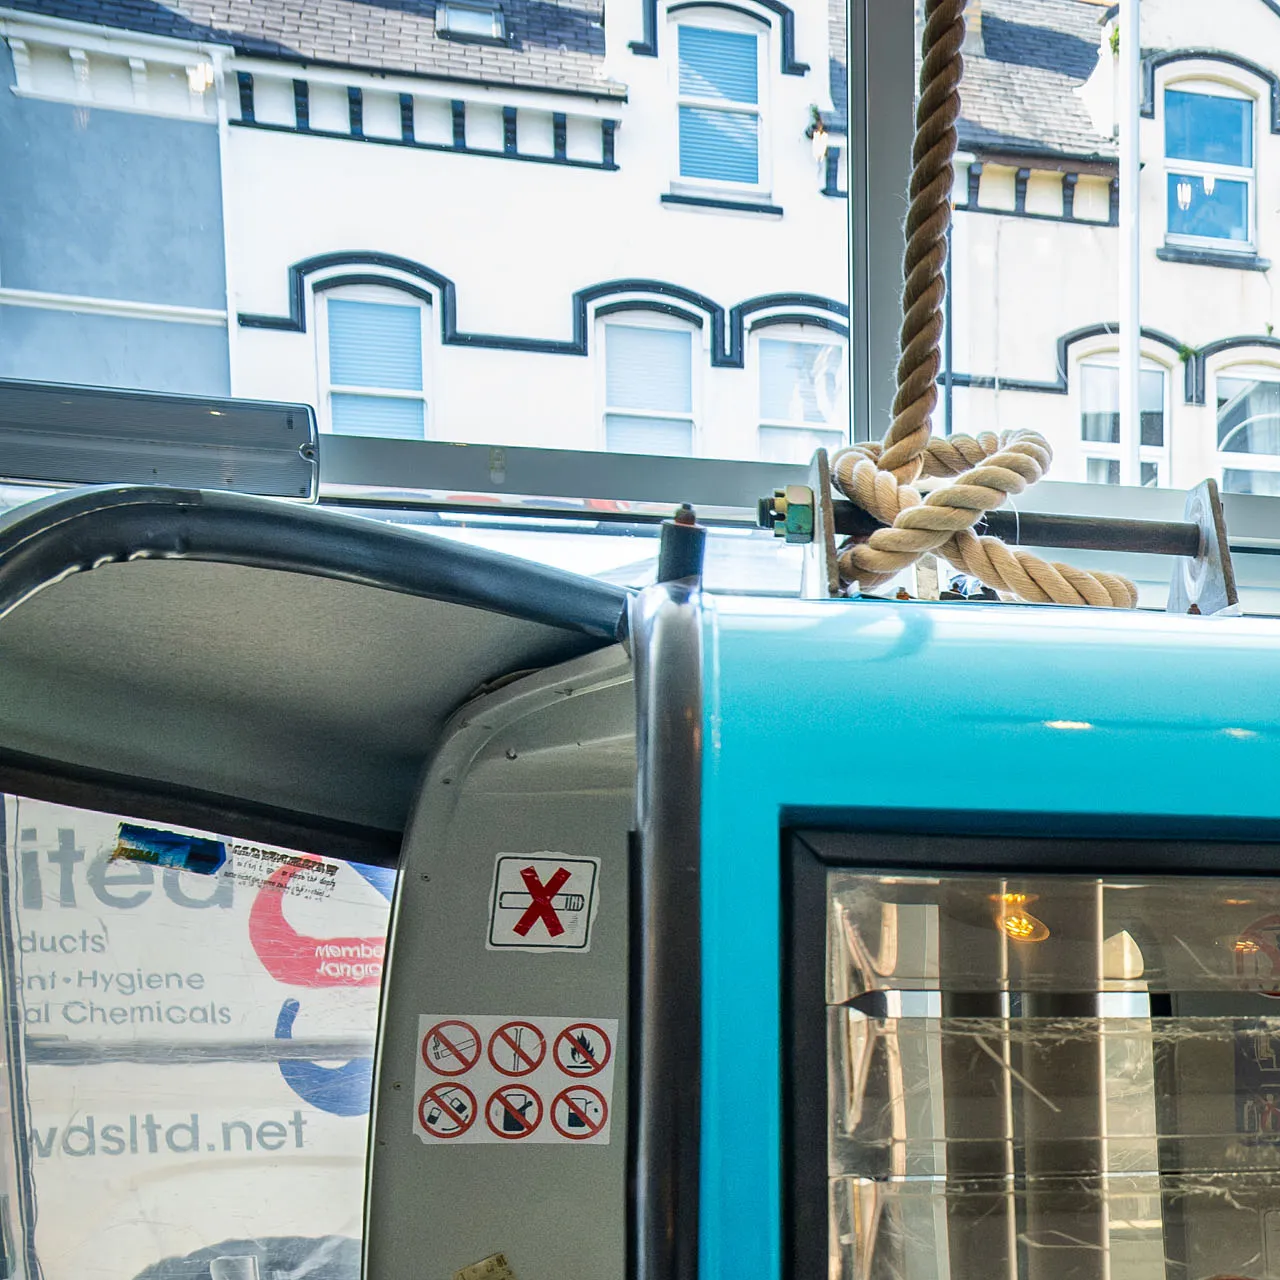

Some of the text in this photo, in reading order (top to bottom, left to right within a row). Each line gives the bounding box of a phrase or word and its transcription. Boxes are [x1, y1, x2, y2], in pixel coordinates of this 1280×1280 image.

[20, 930, 106, 953] ducts
[77, 968, 205, 996] Hygiene
[62, 1001, 232, 1025] Chemicals
